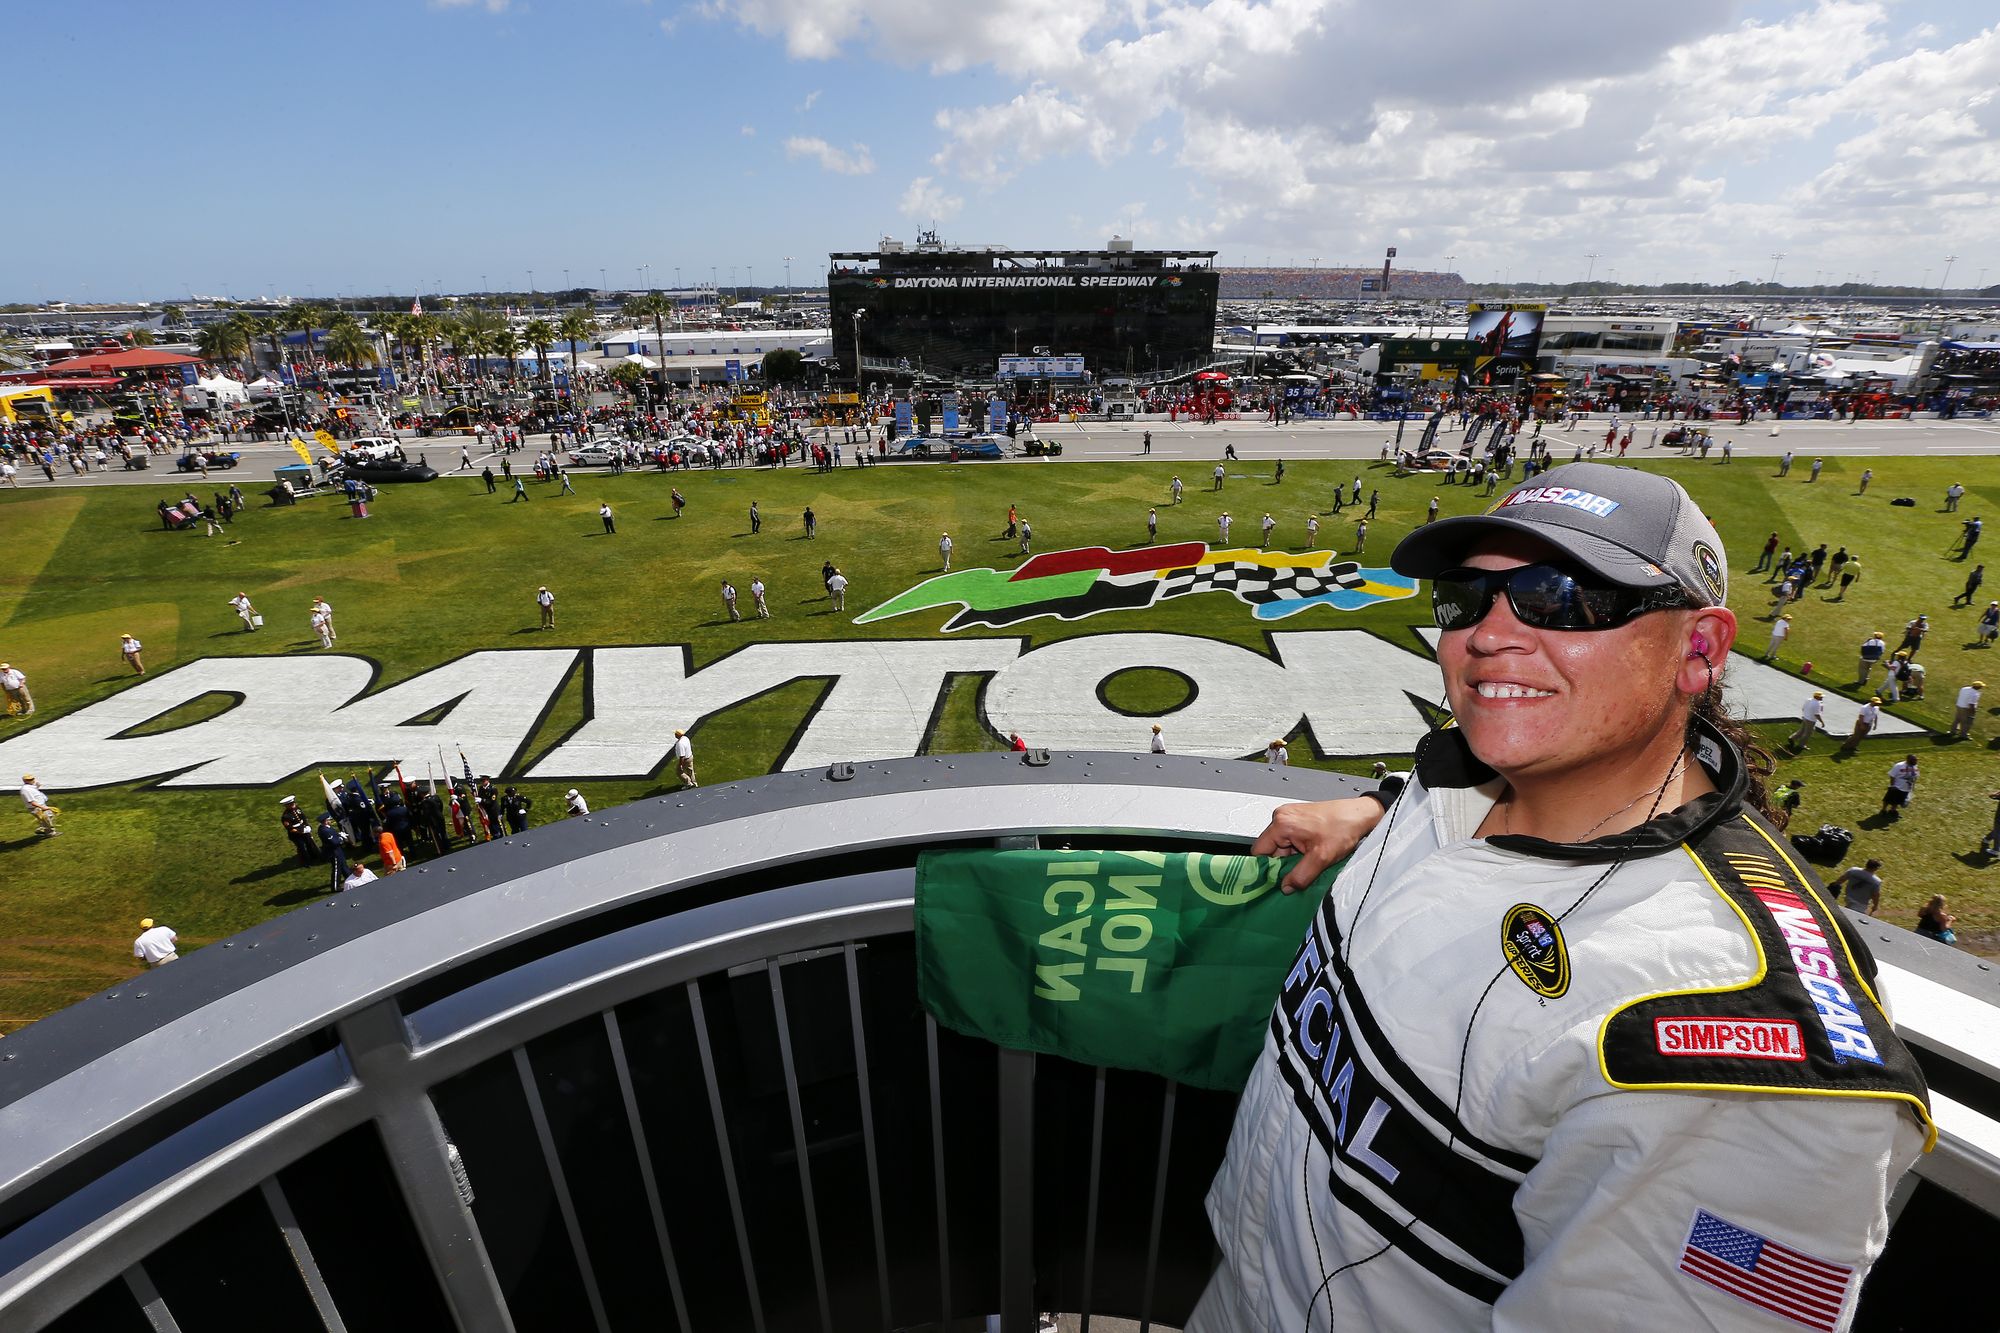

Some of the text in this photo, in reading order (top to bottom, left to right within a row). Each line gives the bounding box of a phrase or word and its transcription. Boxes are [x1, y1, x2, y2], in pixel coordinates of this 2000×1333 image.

[894, 276, 1157, 288] DAYTONA INTERNATIONAL SPEEDWAY
[1484, 303, 1502, 311] Sprint
[1032, 345, 1040, 354] G
[1274, 351, 1282, 360] G
[818, 357, 827, 367] G
[1496, 365, 1520, 376] Sprint
[1286, 388, 1300, 397] 35
[1945, 390, 1957, 398] 51
[1506, 486, 1613, 518] NASCAR
[1516, 930, 1542, 959] Sprint
[1763, 899, 1879, 1062] NASCAR
[1664, 1024, 1790, 1054] SIMPSON
[1284, 920, 1400, 1185] FICIAL
